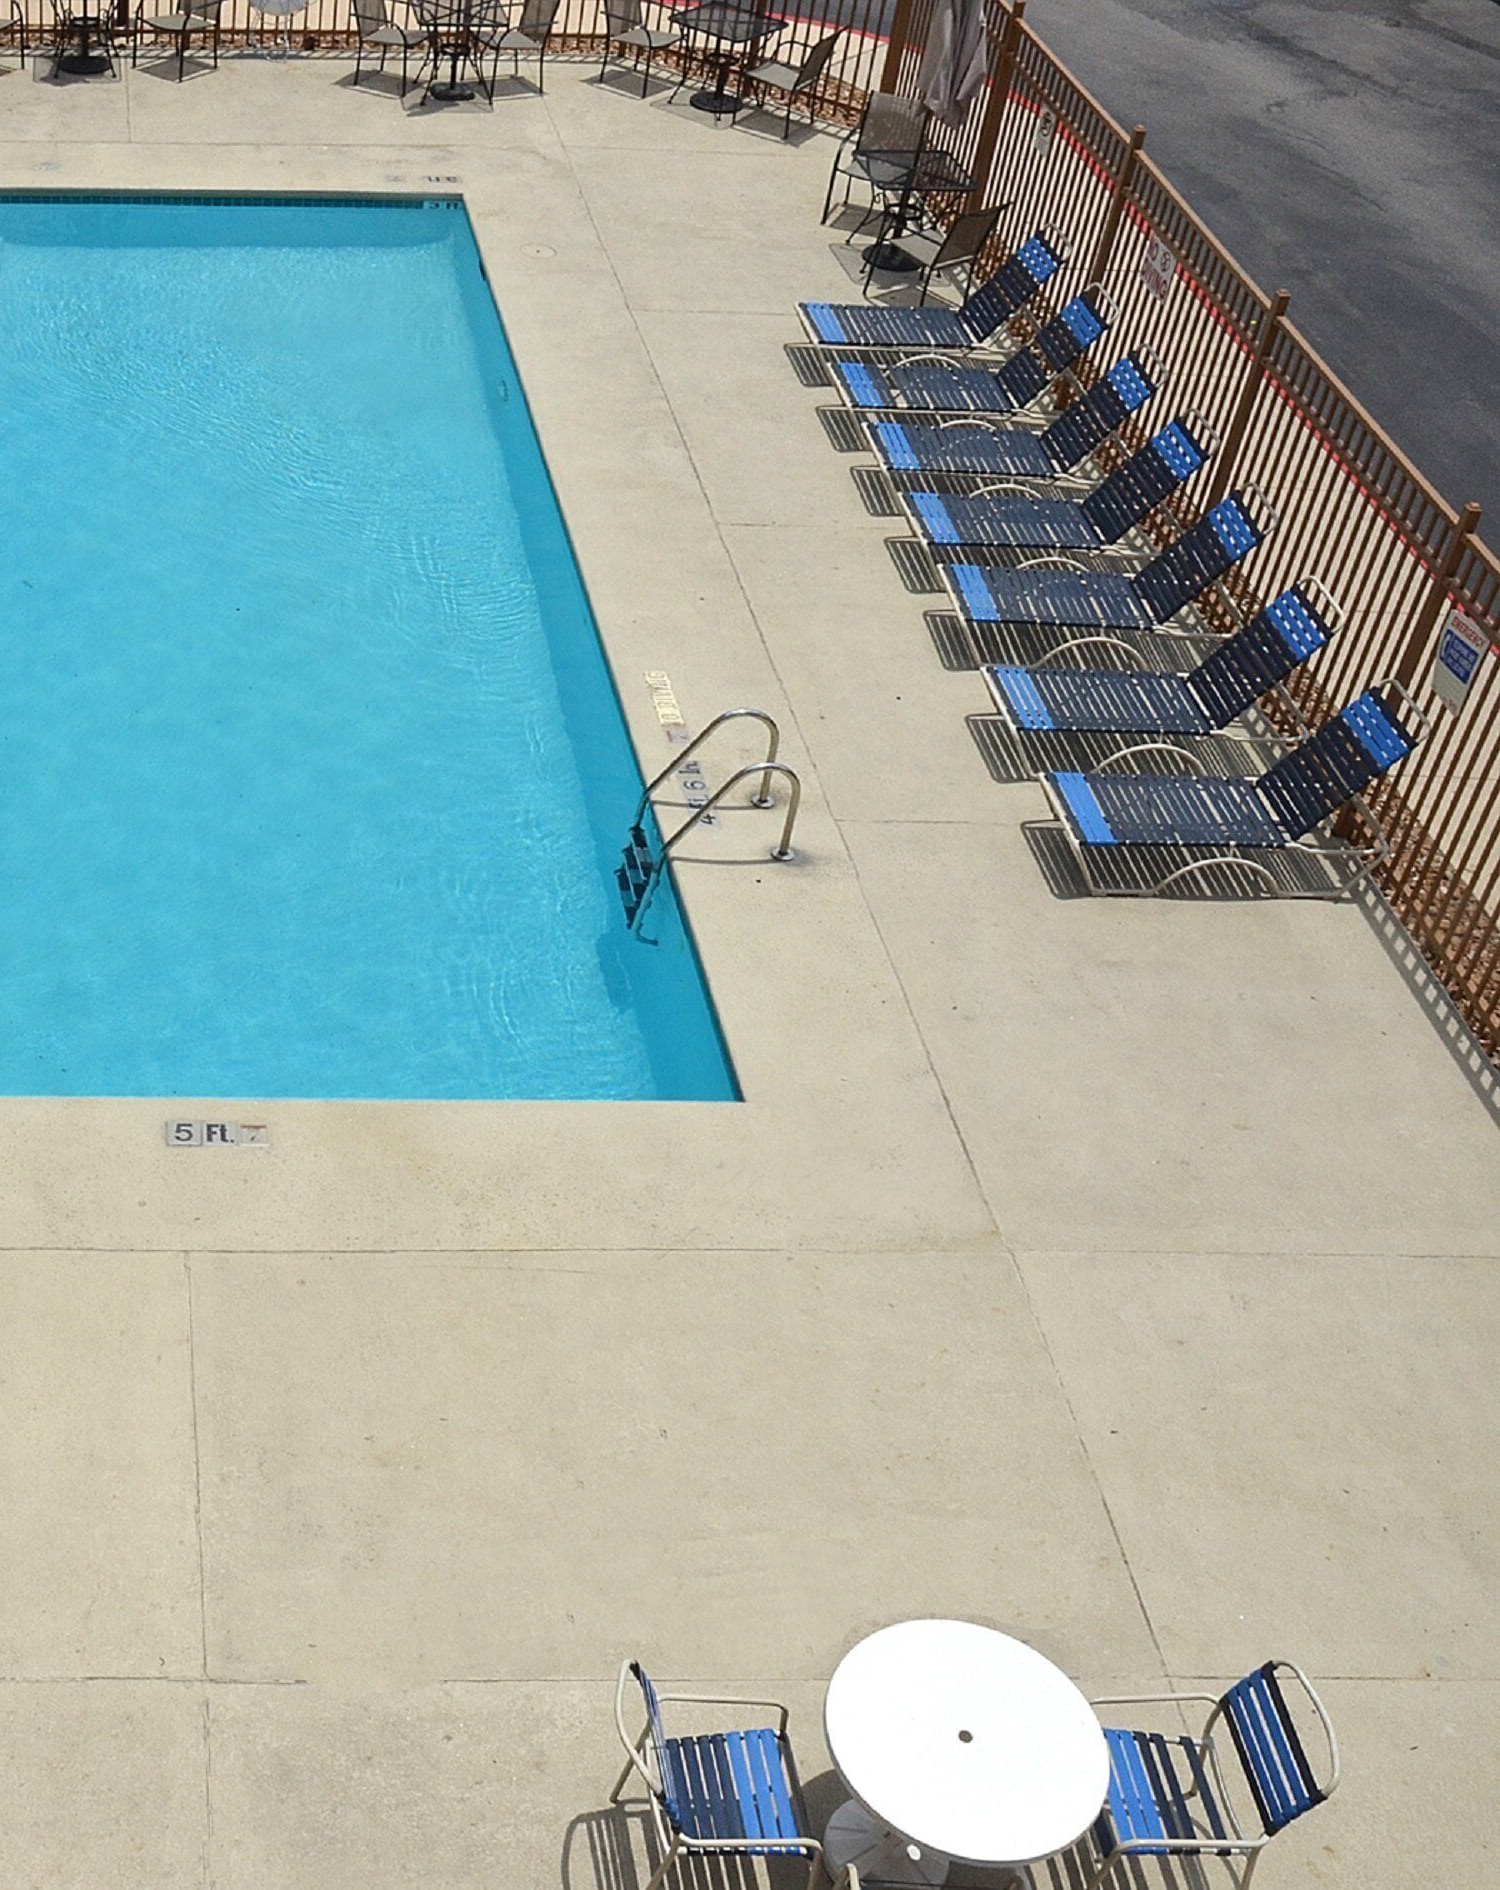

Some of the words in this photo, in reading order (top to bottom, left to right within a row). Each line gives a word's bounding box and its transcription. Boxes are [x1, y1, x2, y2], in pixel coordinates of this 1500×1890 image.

[683, 780, 706, 790] 6
[700, 813, 717, 825] 4
[174, 1123, 193, 1142] 5
[205, 1123, 235, 1143] Ft.
